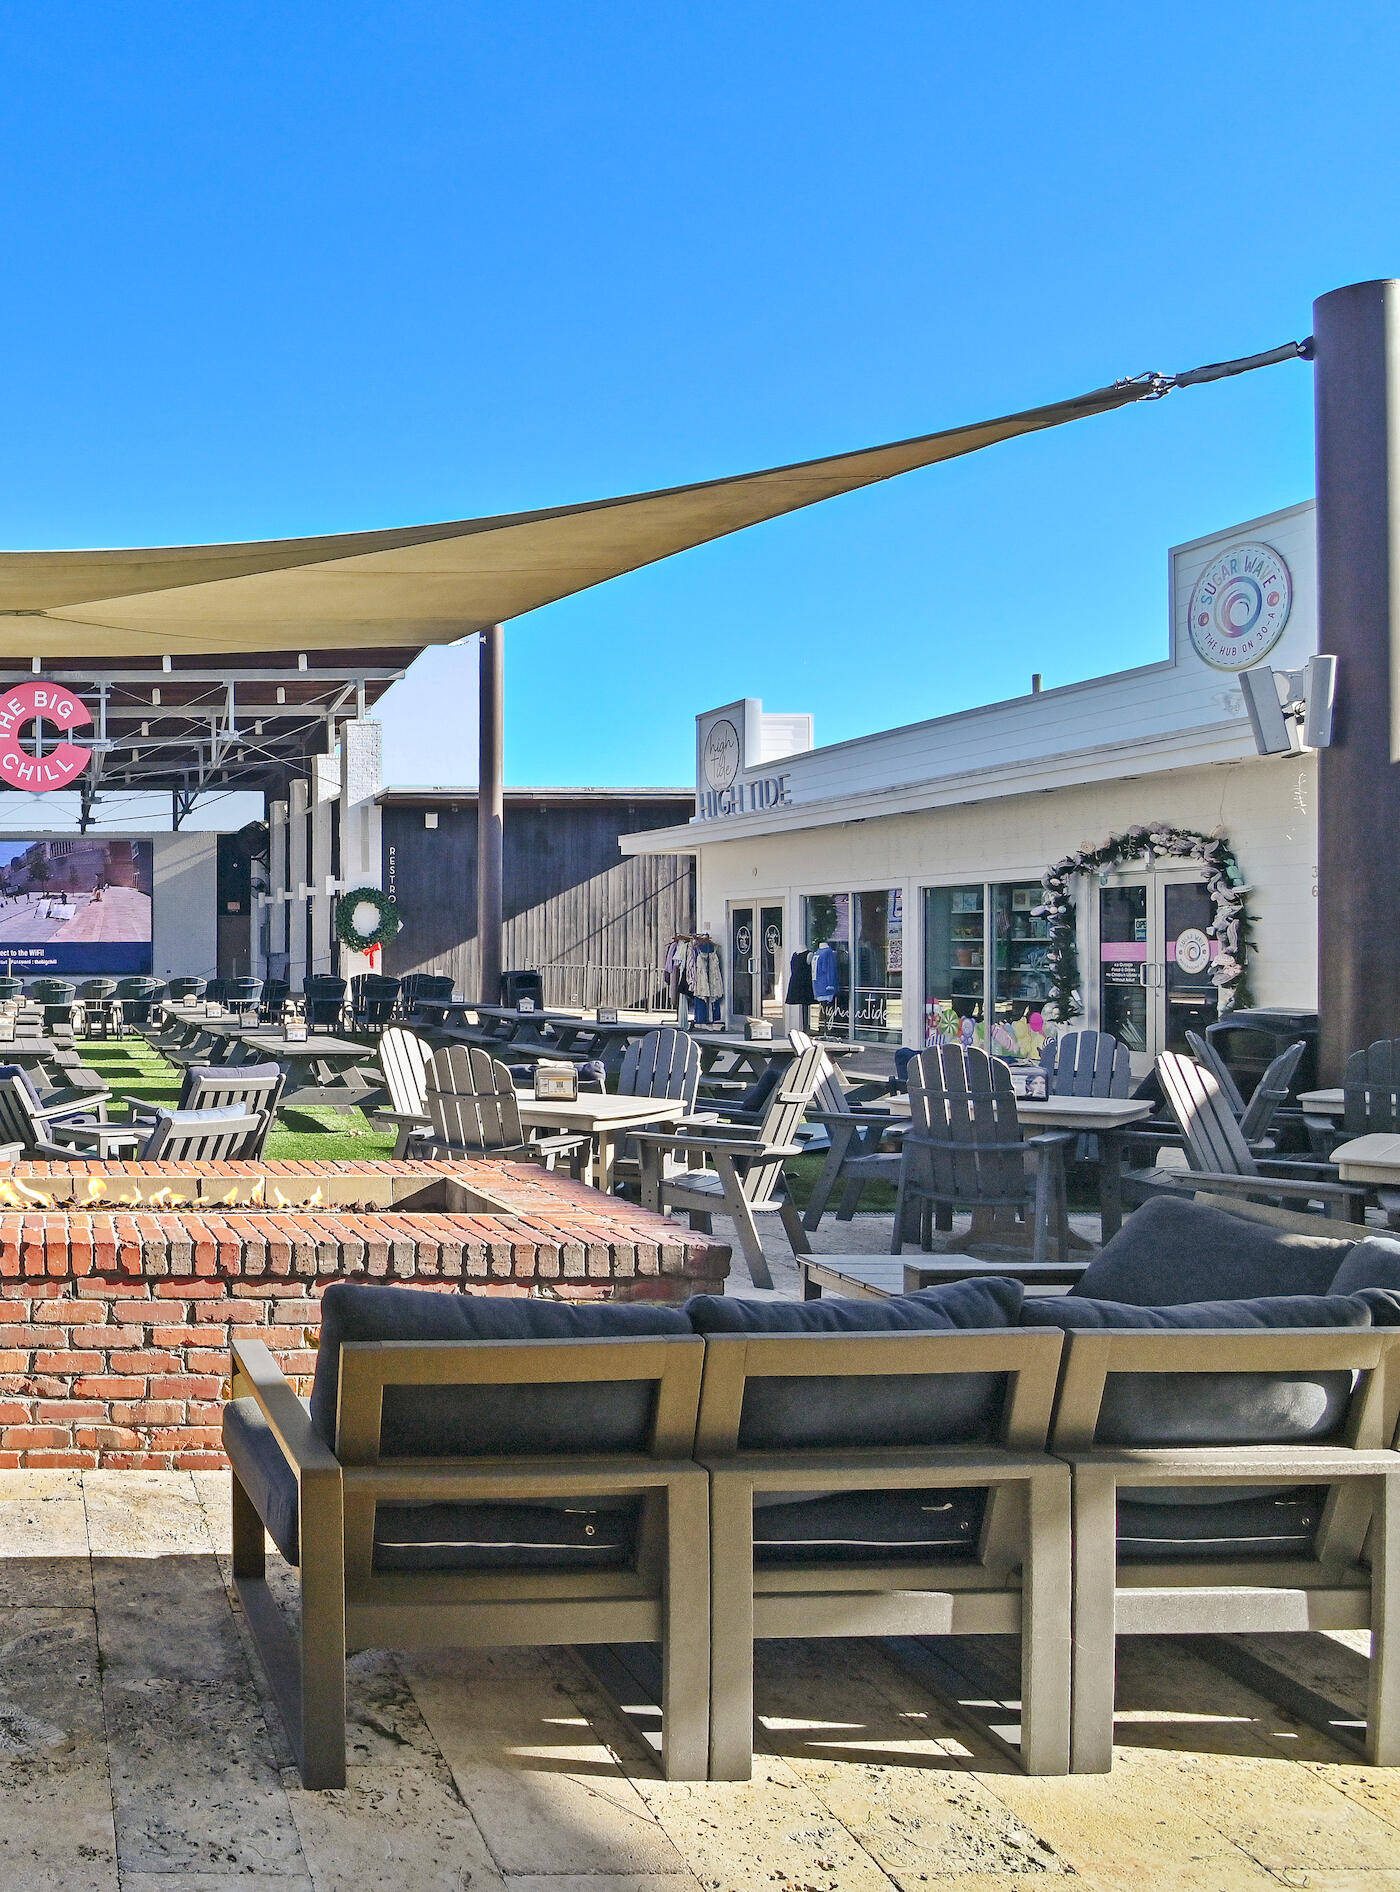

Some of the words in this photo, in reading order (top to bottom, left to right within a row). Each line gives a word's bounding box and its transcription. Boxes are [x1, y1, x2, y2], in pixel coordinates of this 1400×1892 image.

[1201, 558, 1238, 606] SUGAR
[1244, 556, 1277, 589] WAVE
[1204, 632, 1218, 650] THE
[1219, 645, 1237, 657] HUB
[1242, 640, 1254, 653] ON
[1256, 612, 1276, 641] 30-A
[34, 690, 74, 720] BIG
[2, 753, 75, 782] CHILL
[699, 784, 744, 820] HIGH
[745, 773, 792, 811] TIDE
[388, 846, 396, 903] RESTRO
